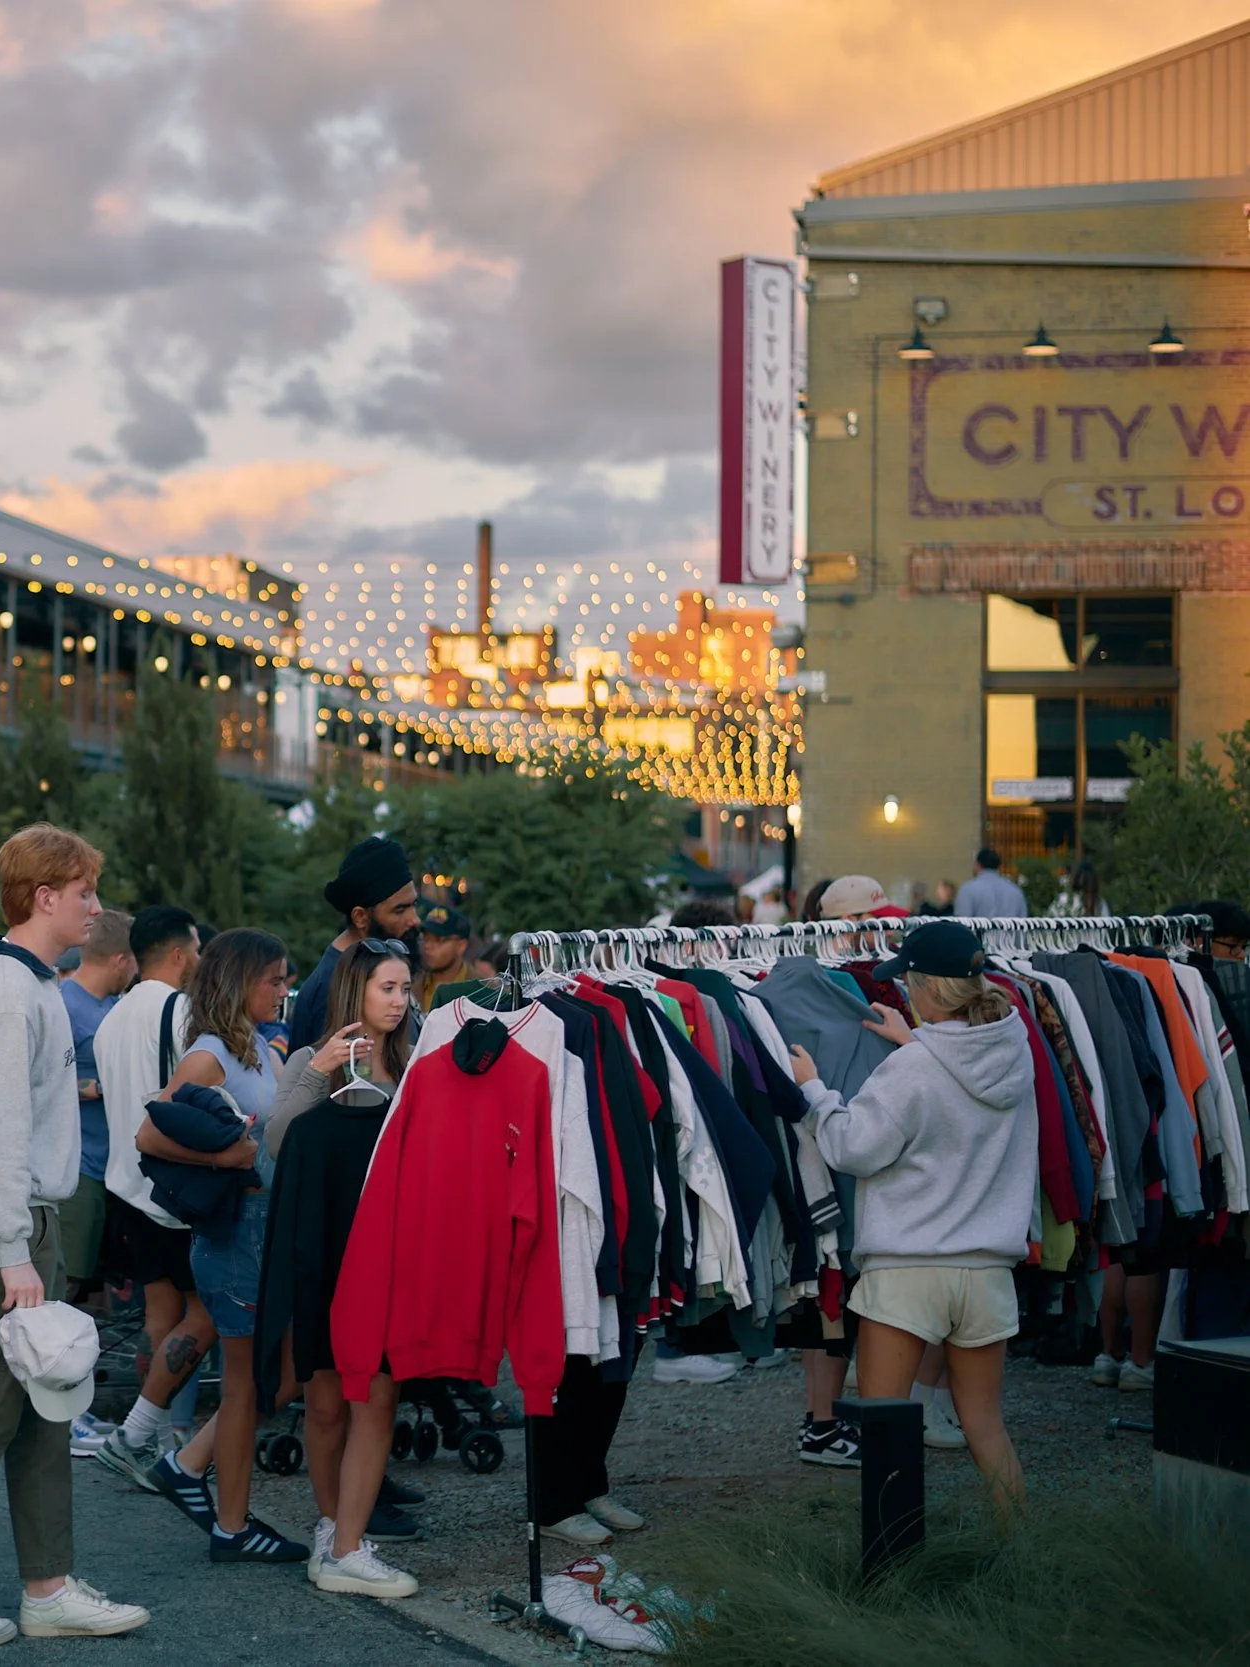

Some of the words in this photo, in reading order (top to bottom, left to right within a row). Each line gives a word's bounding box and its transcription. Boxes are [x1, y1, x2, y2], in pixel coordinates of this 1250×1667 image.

[761, 277, 781, 389] CITY
[961, 402, 1152, 470] CITY
[758, 400, 783, 567] WINERY
[1093, 484, 1153, 522] ST.
[1175, 484, 1246, 519] LO
